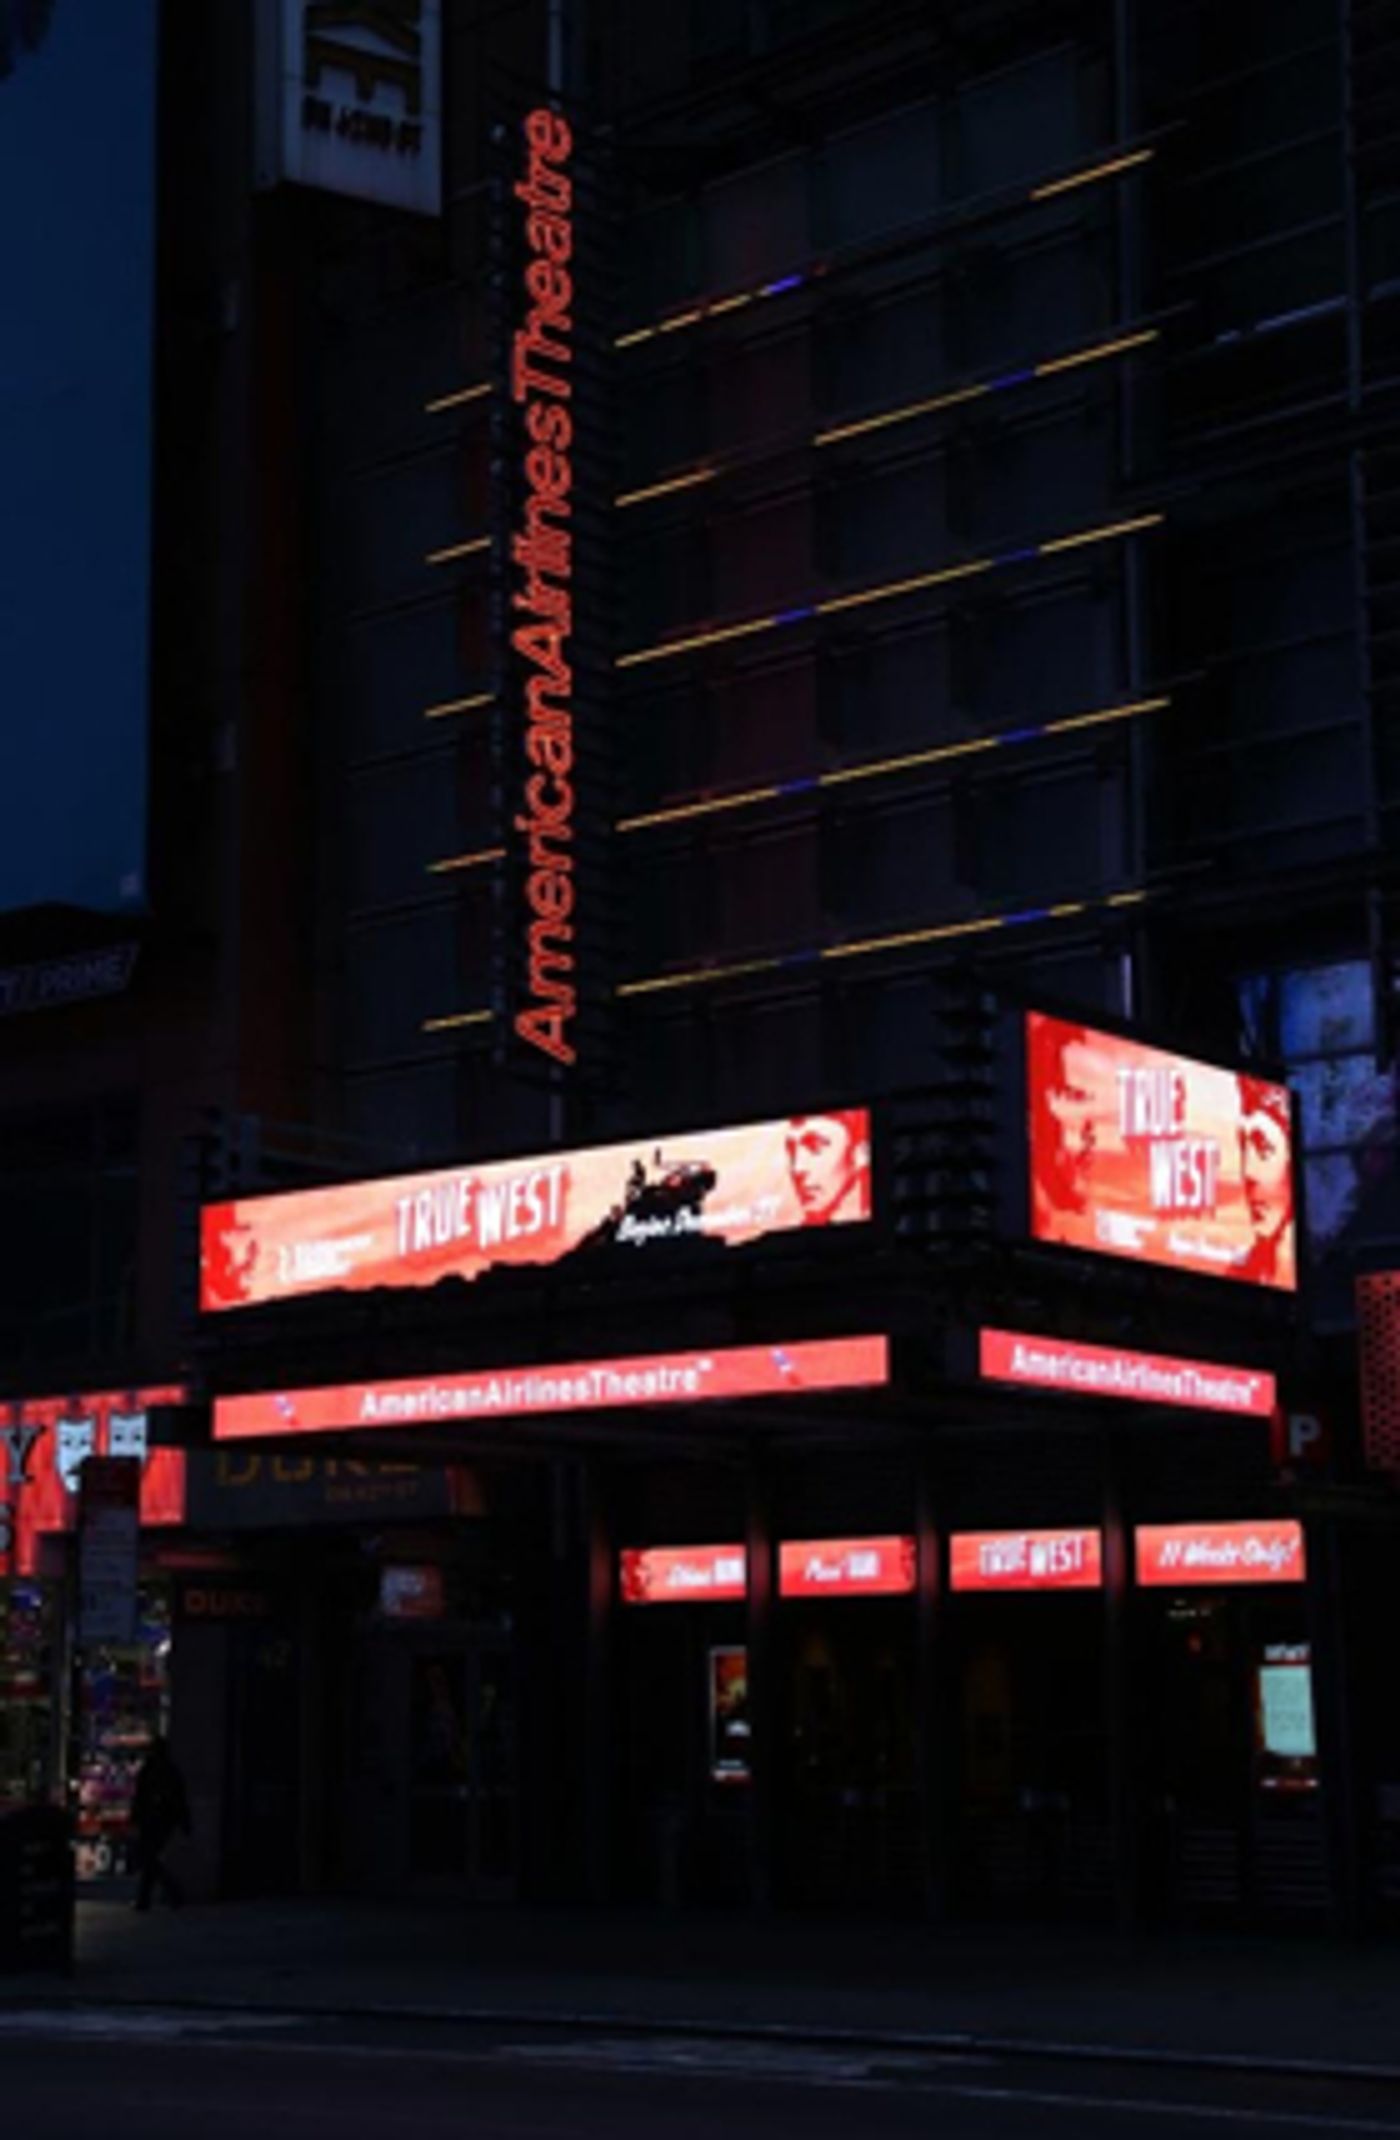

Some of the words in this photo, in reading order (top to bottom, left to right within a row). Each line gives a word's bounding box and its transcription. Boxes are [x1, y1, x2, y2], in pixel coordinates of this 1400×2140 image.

[512, 108, 577, 1066] AmericanAirlinesTheatre
[1116, 1066, 1186, 1137] TRUE
[394, 1175, 472, 1258] TRUE
[476, 1162, 565, 1251] WEST
[1149, 1136, 1220, 1209] WEST
